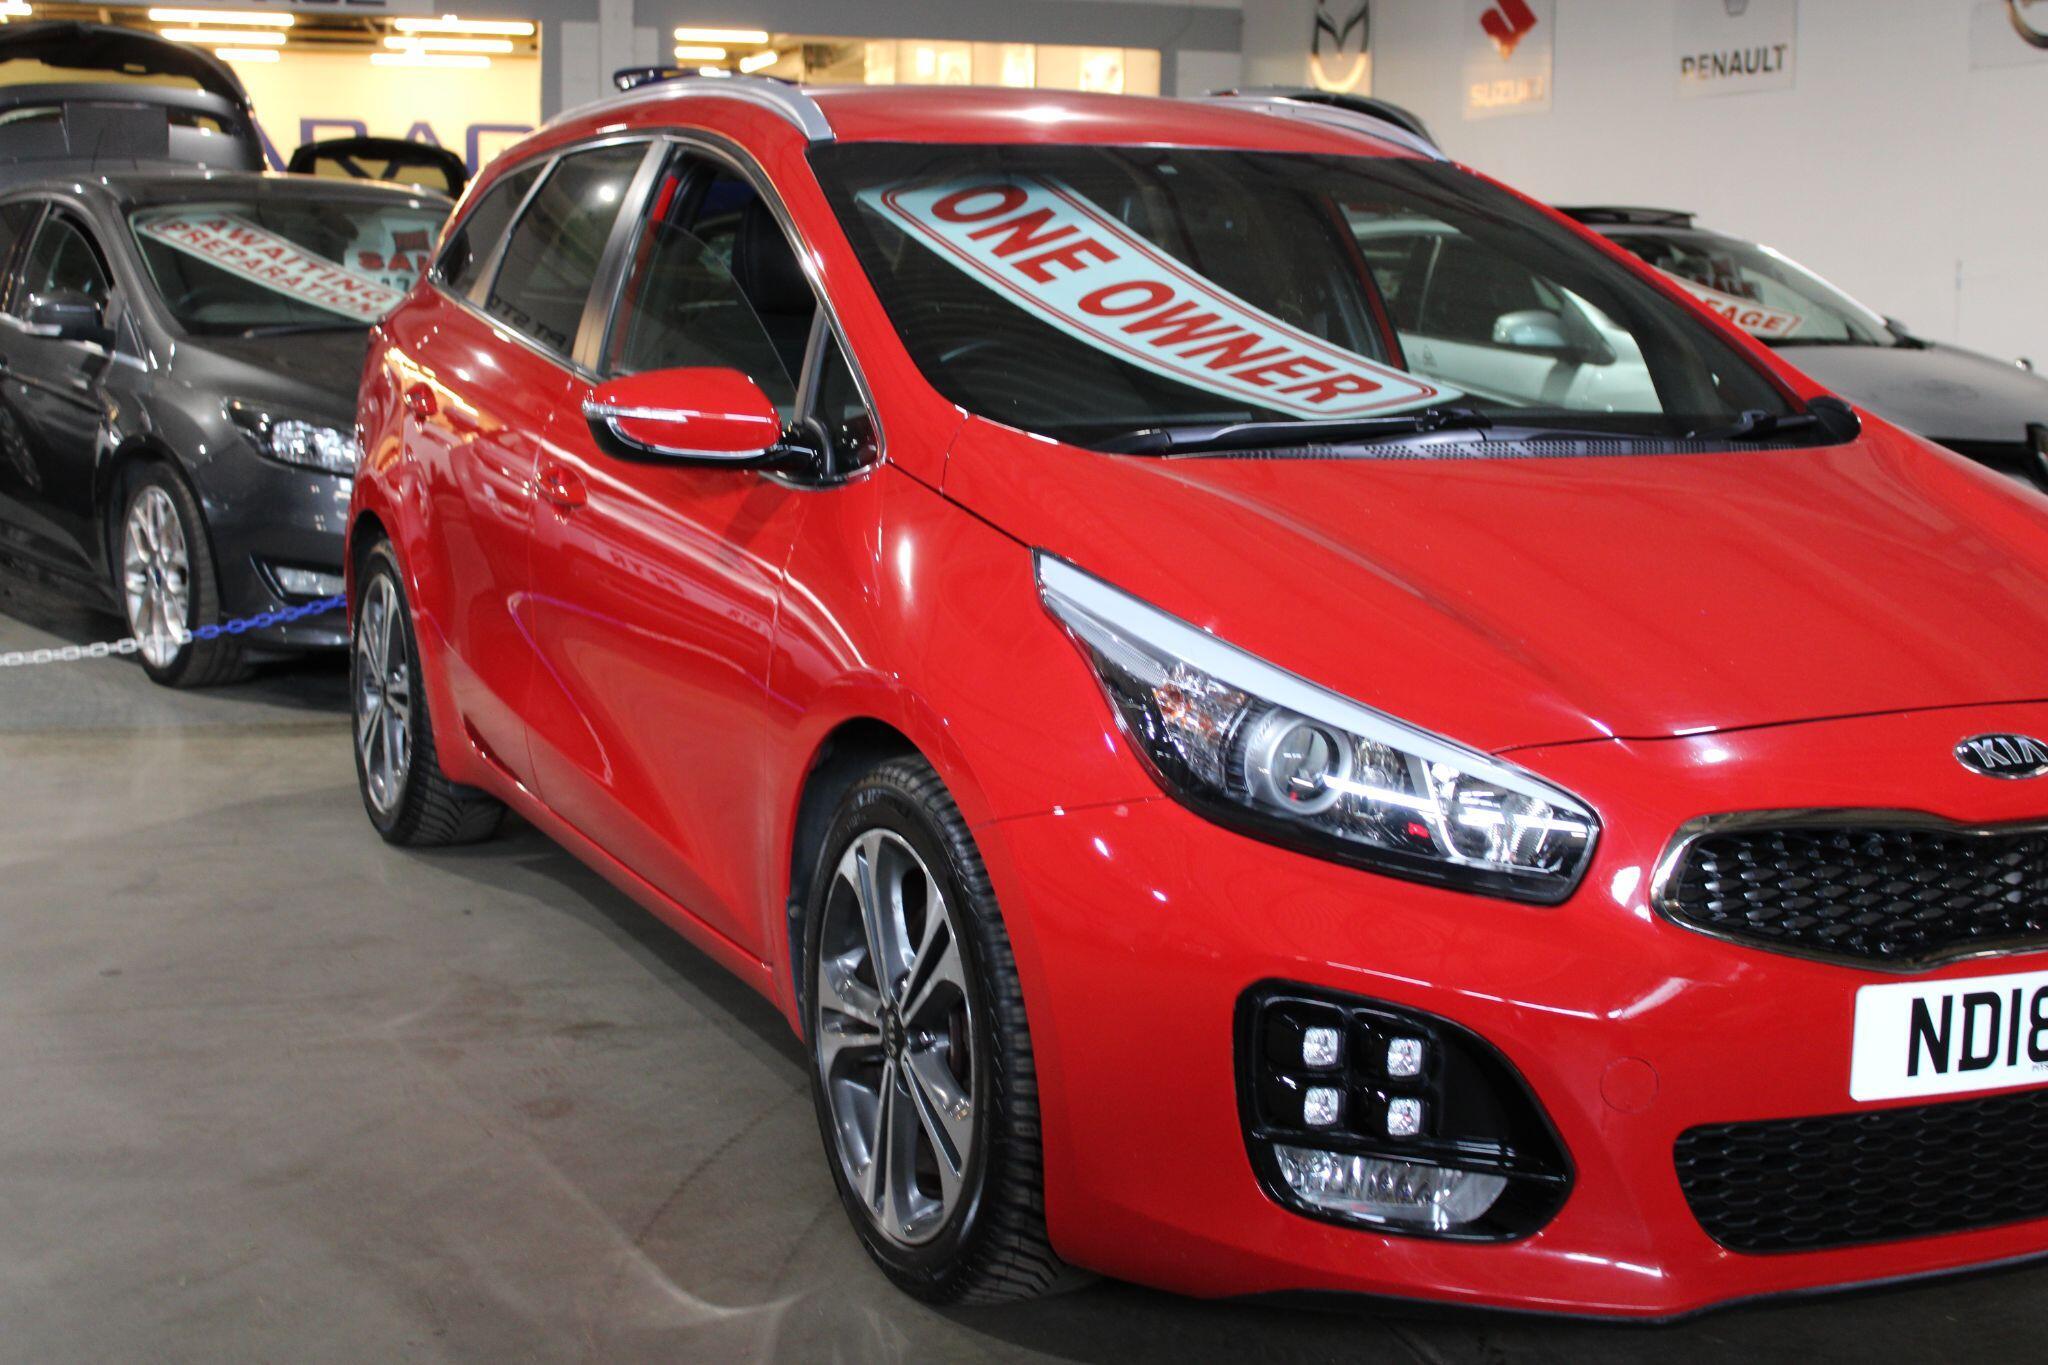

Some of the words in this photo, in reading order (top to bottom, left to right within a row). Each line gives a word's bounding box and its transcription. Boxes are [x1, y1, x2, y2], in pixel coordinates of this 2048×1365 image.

[1681, 44, 1787, 80] RENAULT
[160, 219, 381, 315] PREPARATION
[198, 218, 396, 303] AWAITING
[931, 184, 1120, 286] ONE
[1078, 280, 1383, 409] OWNER
[1967, 737, 2048, 768] KIA
